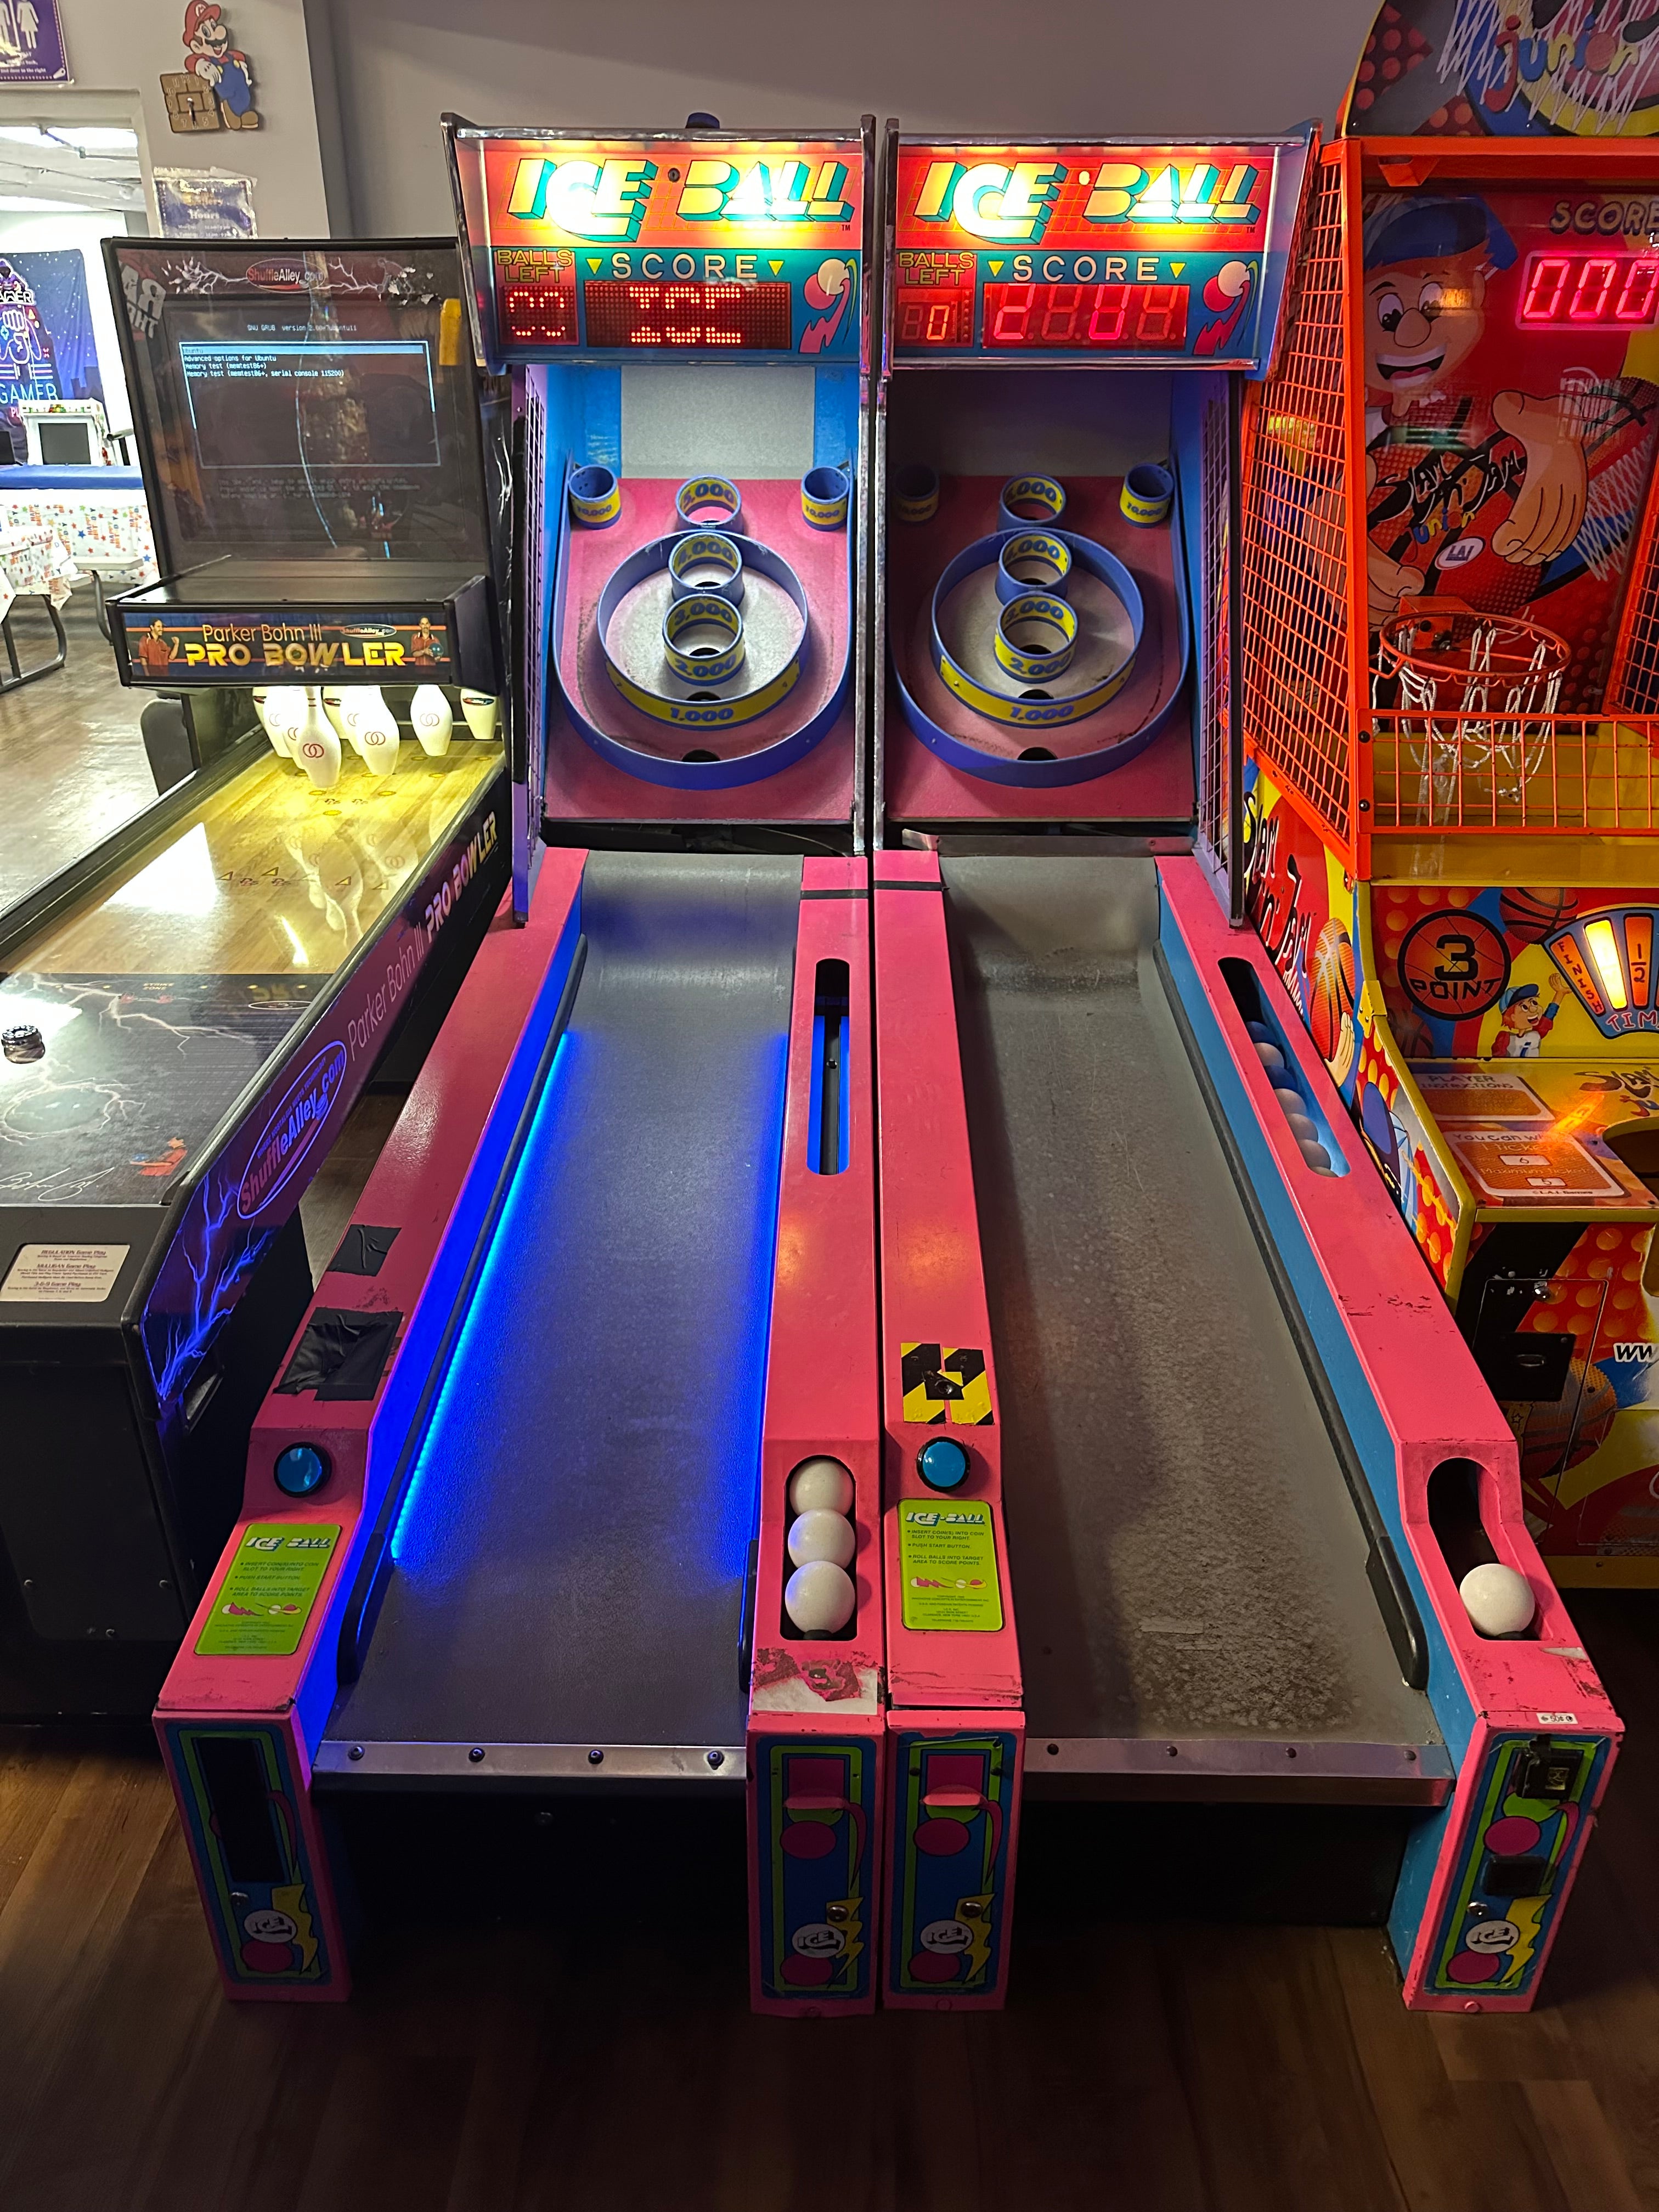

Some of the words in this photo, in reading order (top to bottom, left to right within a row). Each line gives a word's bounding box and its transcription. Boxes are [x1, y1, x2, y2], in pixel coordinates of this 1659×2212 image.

[507, 158, 658, 242] ICE
[676, 159, 854, 222] BALL
[914, 162, 1068, 245] ICE
[1082, 163, 1260, 224] BALL
[1549, 200, 1659, 235] SCORE
[496, 249, 573, 266] BALLS
[612, 253, 758, 279] SCORE
[898, 252, 974, 268] BALLS
[505, 267, 565, 283] LEFT
[904, 269, 965, 285] LEFT
[1013, 256, 1160, 281] SCORE
[577, 504, 612, 517] 10,000
[806, 504, 840, 518] 10,000
[1127, 501, 1164, 516] 10,000
[674, 602, 733, 625] 3,000
[202, 625, 256, 643] Parker
[262, 624, 307, 641] Bohn
[310, 624, 323, 640] III
[185, 643, 252, 667] PRO
[263, 642, 407, 667] BOWLER
[676, 654, 736, 677] 2,000
[670, 707, 734, 721] 1,000
[1009, 705, 1074, 720] 1,000
[347, 983, 387, 1061] Parker
[387, 944, 416, 1003] Bohn
[425, 881, 452, 944] PRO
[453, 811, 498, 901] BOWLER
[1434, 934, 1479, 981] 3
[1557, 941, 1603, 1013] FINISH
[1409, 979, 1503, 1001] POINT
[1607, 1011, 1659, 1031] TIM
[245, 1537, 285, 1551] ICE
[286, 1538, 331, 1548] BALL
[797, 1930, 840, 1951] ICE
[926, 1926, 969, 1948] ICE
[1471, 1926, 1515, 1946] ICE
